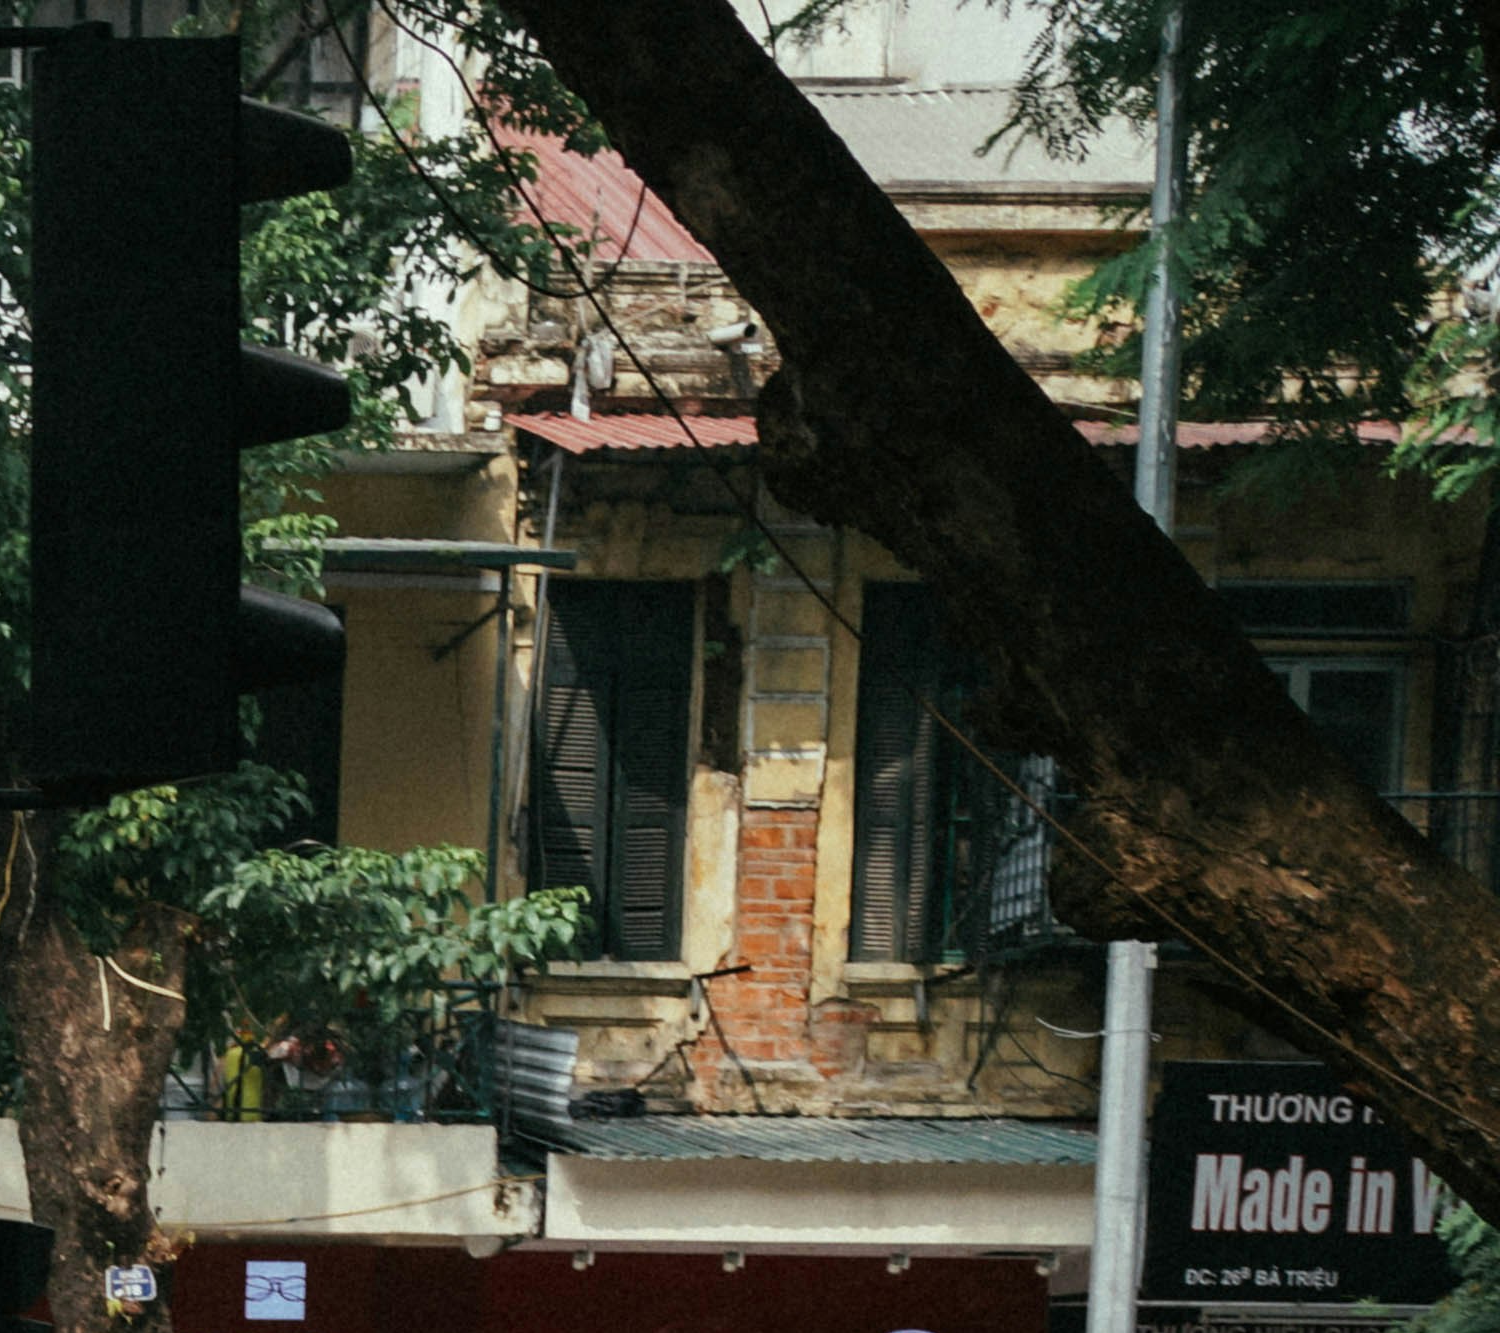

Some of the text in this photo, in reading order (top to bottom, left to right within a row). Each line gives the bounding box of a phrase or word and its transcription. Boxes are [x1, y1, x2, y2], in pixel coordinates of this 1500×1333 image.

[1209, 1092, 1353, 1124] THƯƠNG
[1191, 1153, 1333, 1234] Made
[1346, 1155, 1396, 1234] in
